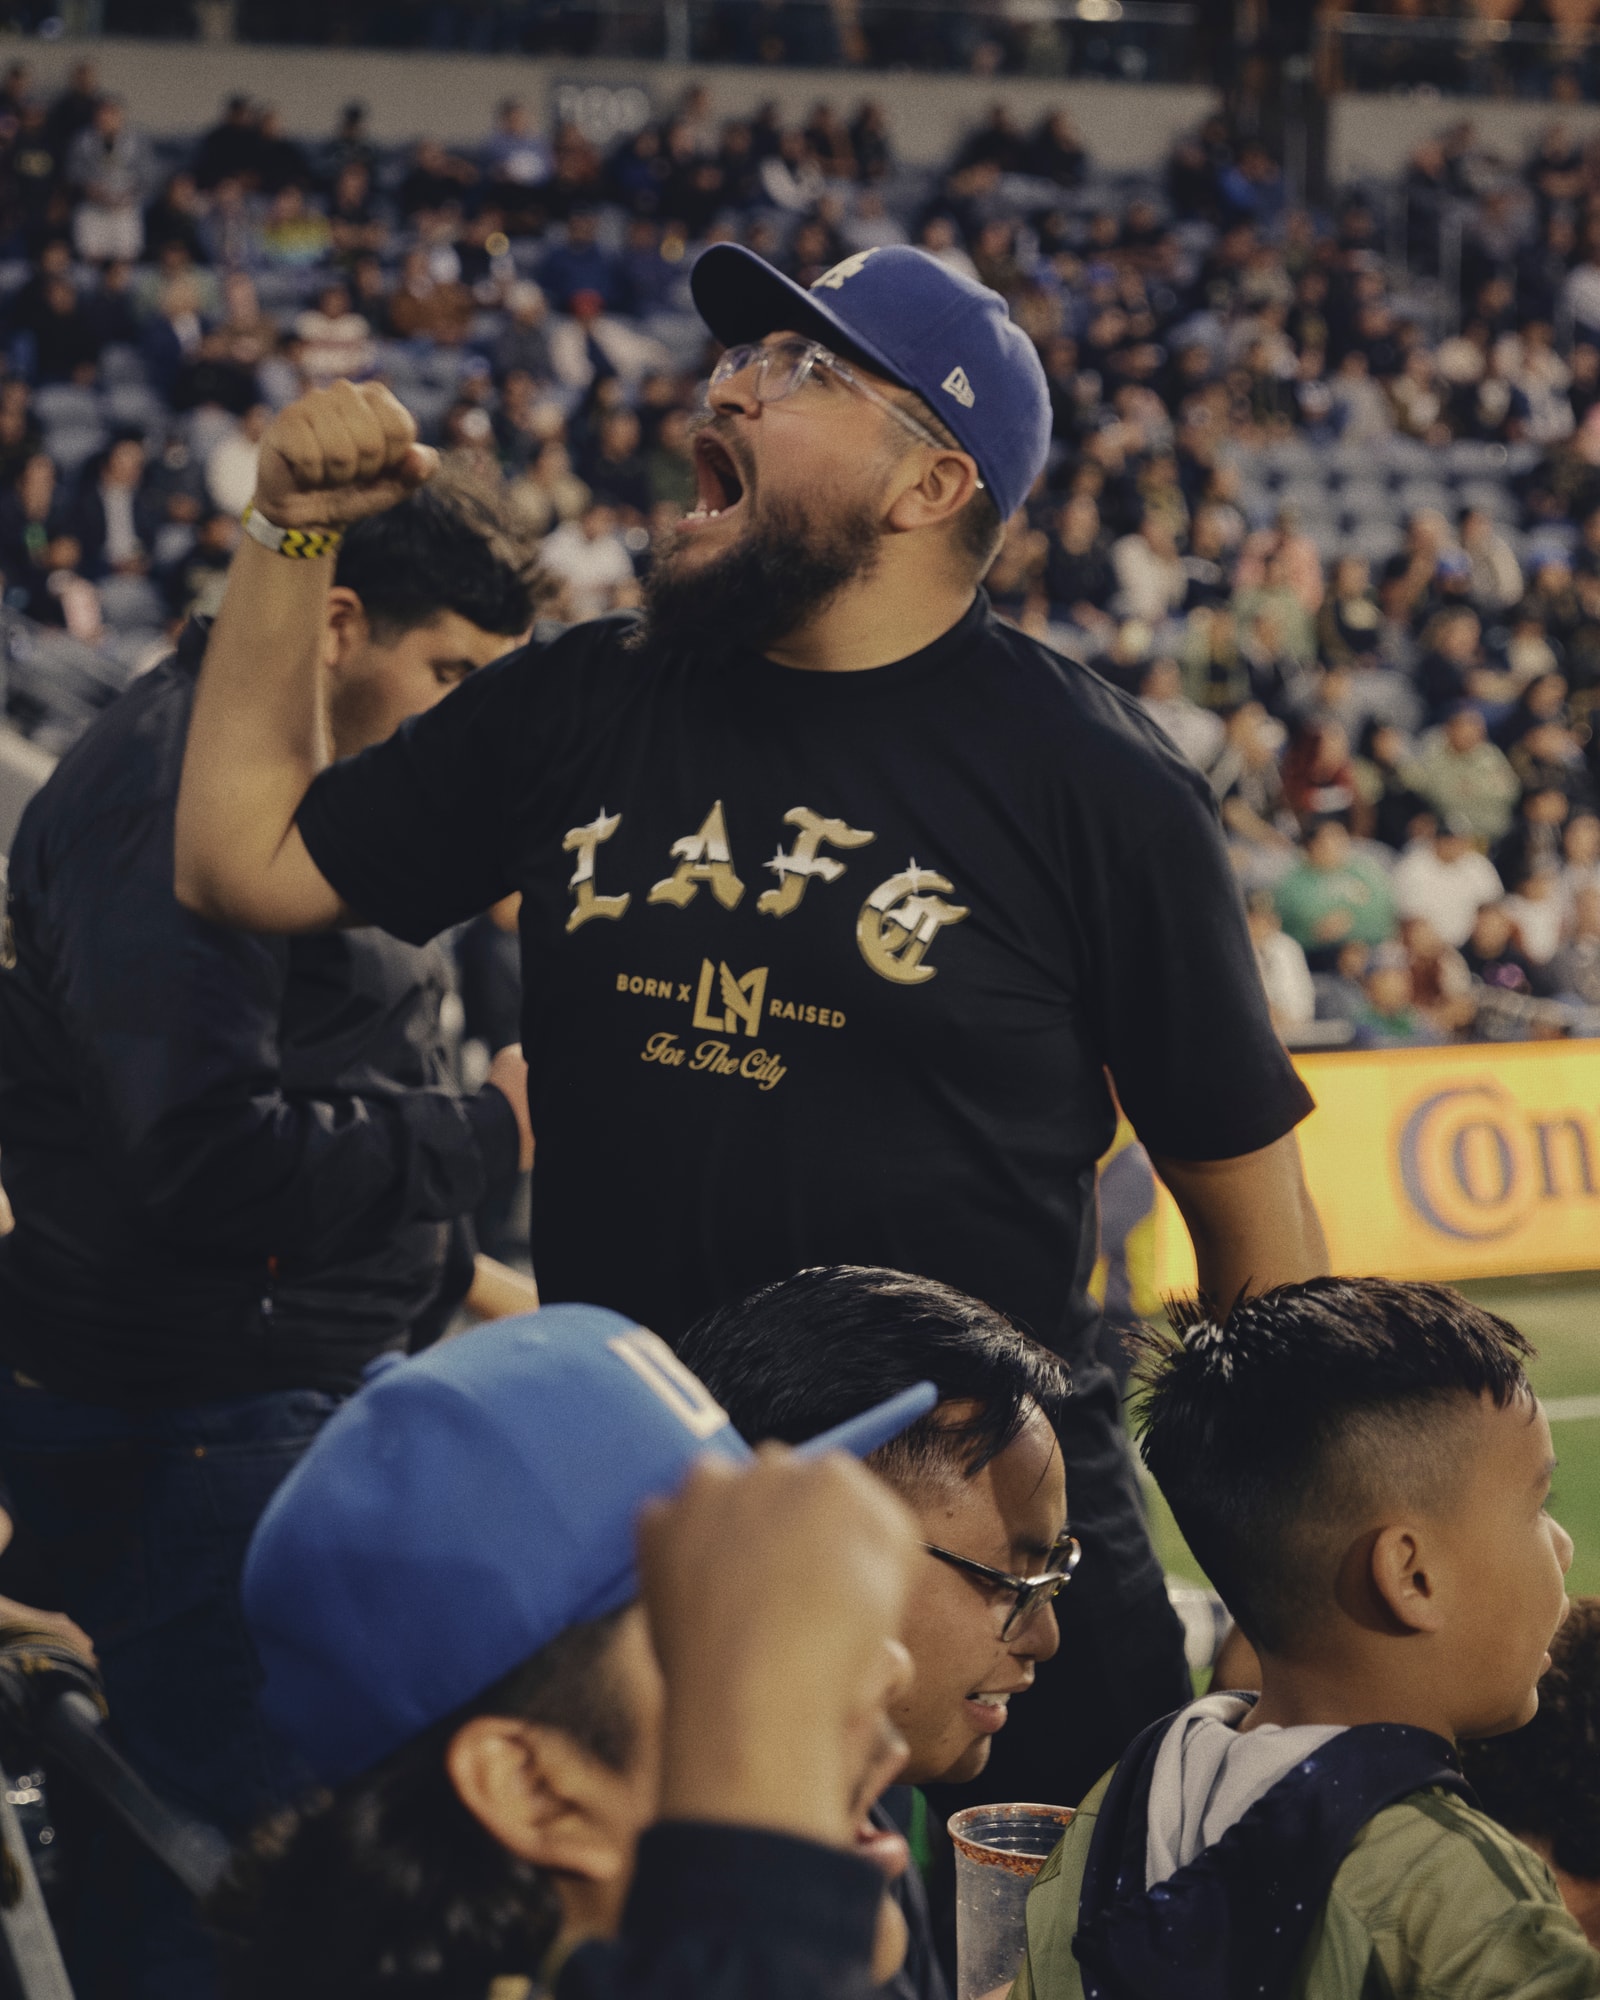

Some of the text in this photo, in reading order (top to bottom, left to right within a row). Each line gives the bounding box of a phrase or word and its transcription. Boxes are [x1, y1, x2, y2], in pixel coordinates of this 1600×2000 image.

[562, 800, 970, 984] LAFC
[616, 973, 846, 1029] BORN X RAISED
[641, 1032, 788, 1091] For The City
